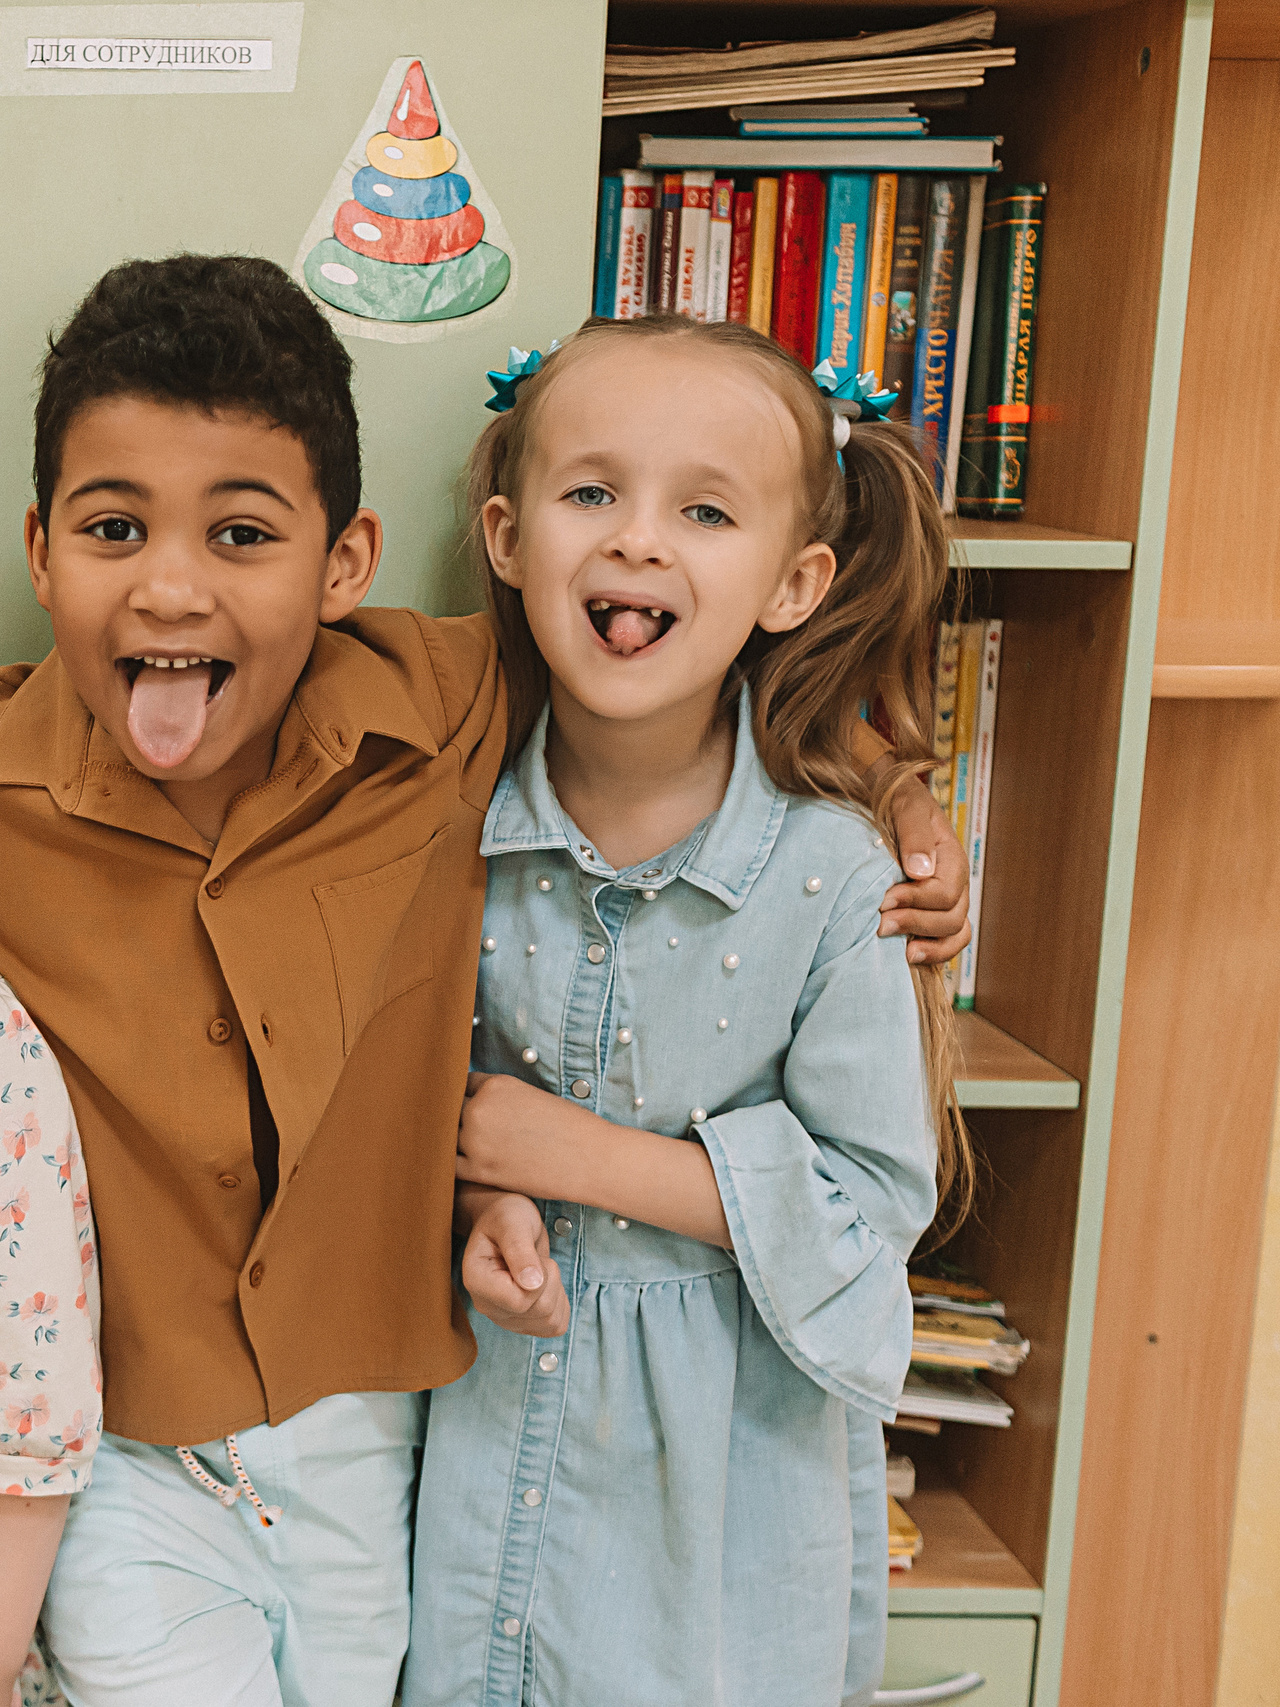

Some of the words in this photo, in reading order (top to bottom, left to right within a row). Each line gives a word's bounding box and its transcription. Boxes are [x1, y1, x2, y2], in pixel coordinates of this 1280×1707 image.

[30, 44, 75, 65] ДЛЯ
[82, 44, 252, 67] СОТРУДНИКОВ
[1020, 228, 1038, 310] ПЕРРО
[923, 249, 954, 418] ХРЕСТОМАТИЯ
